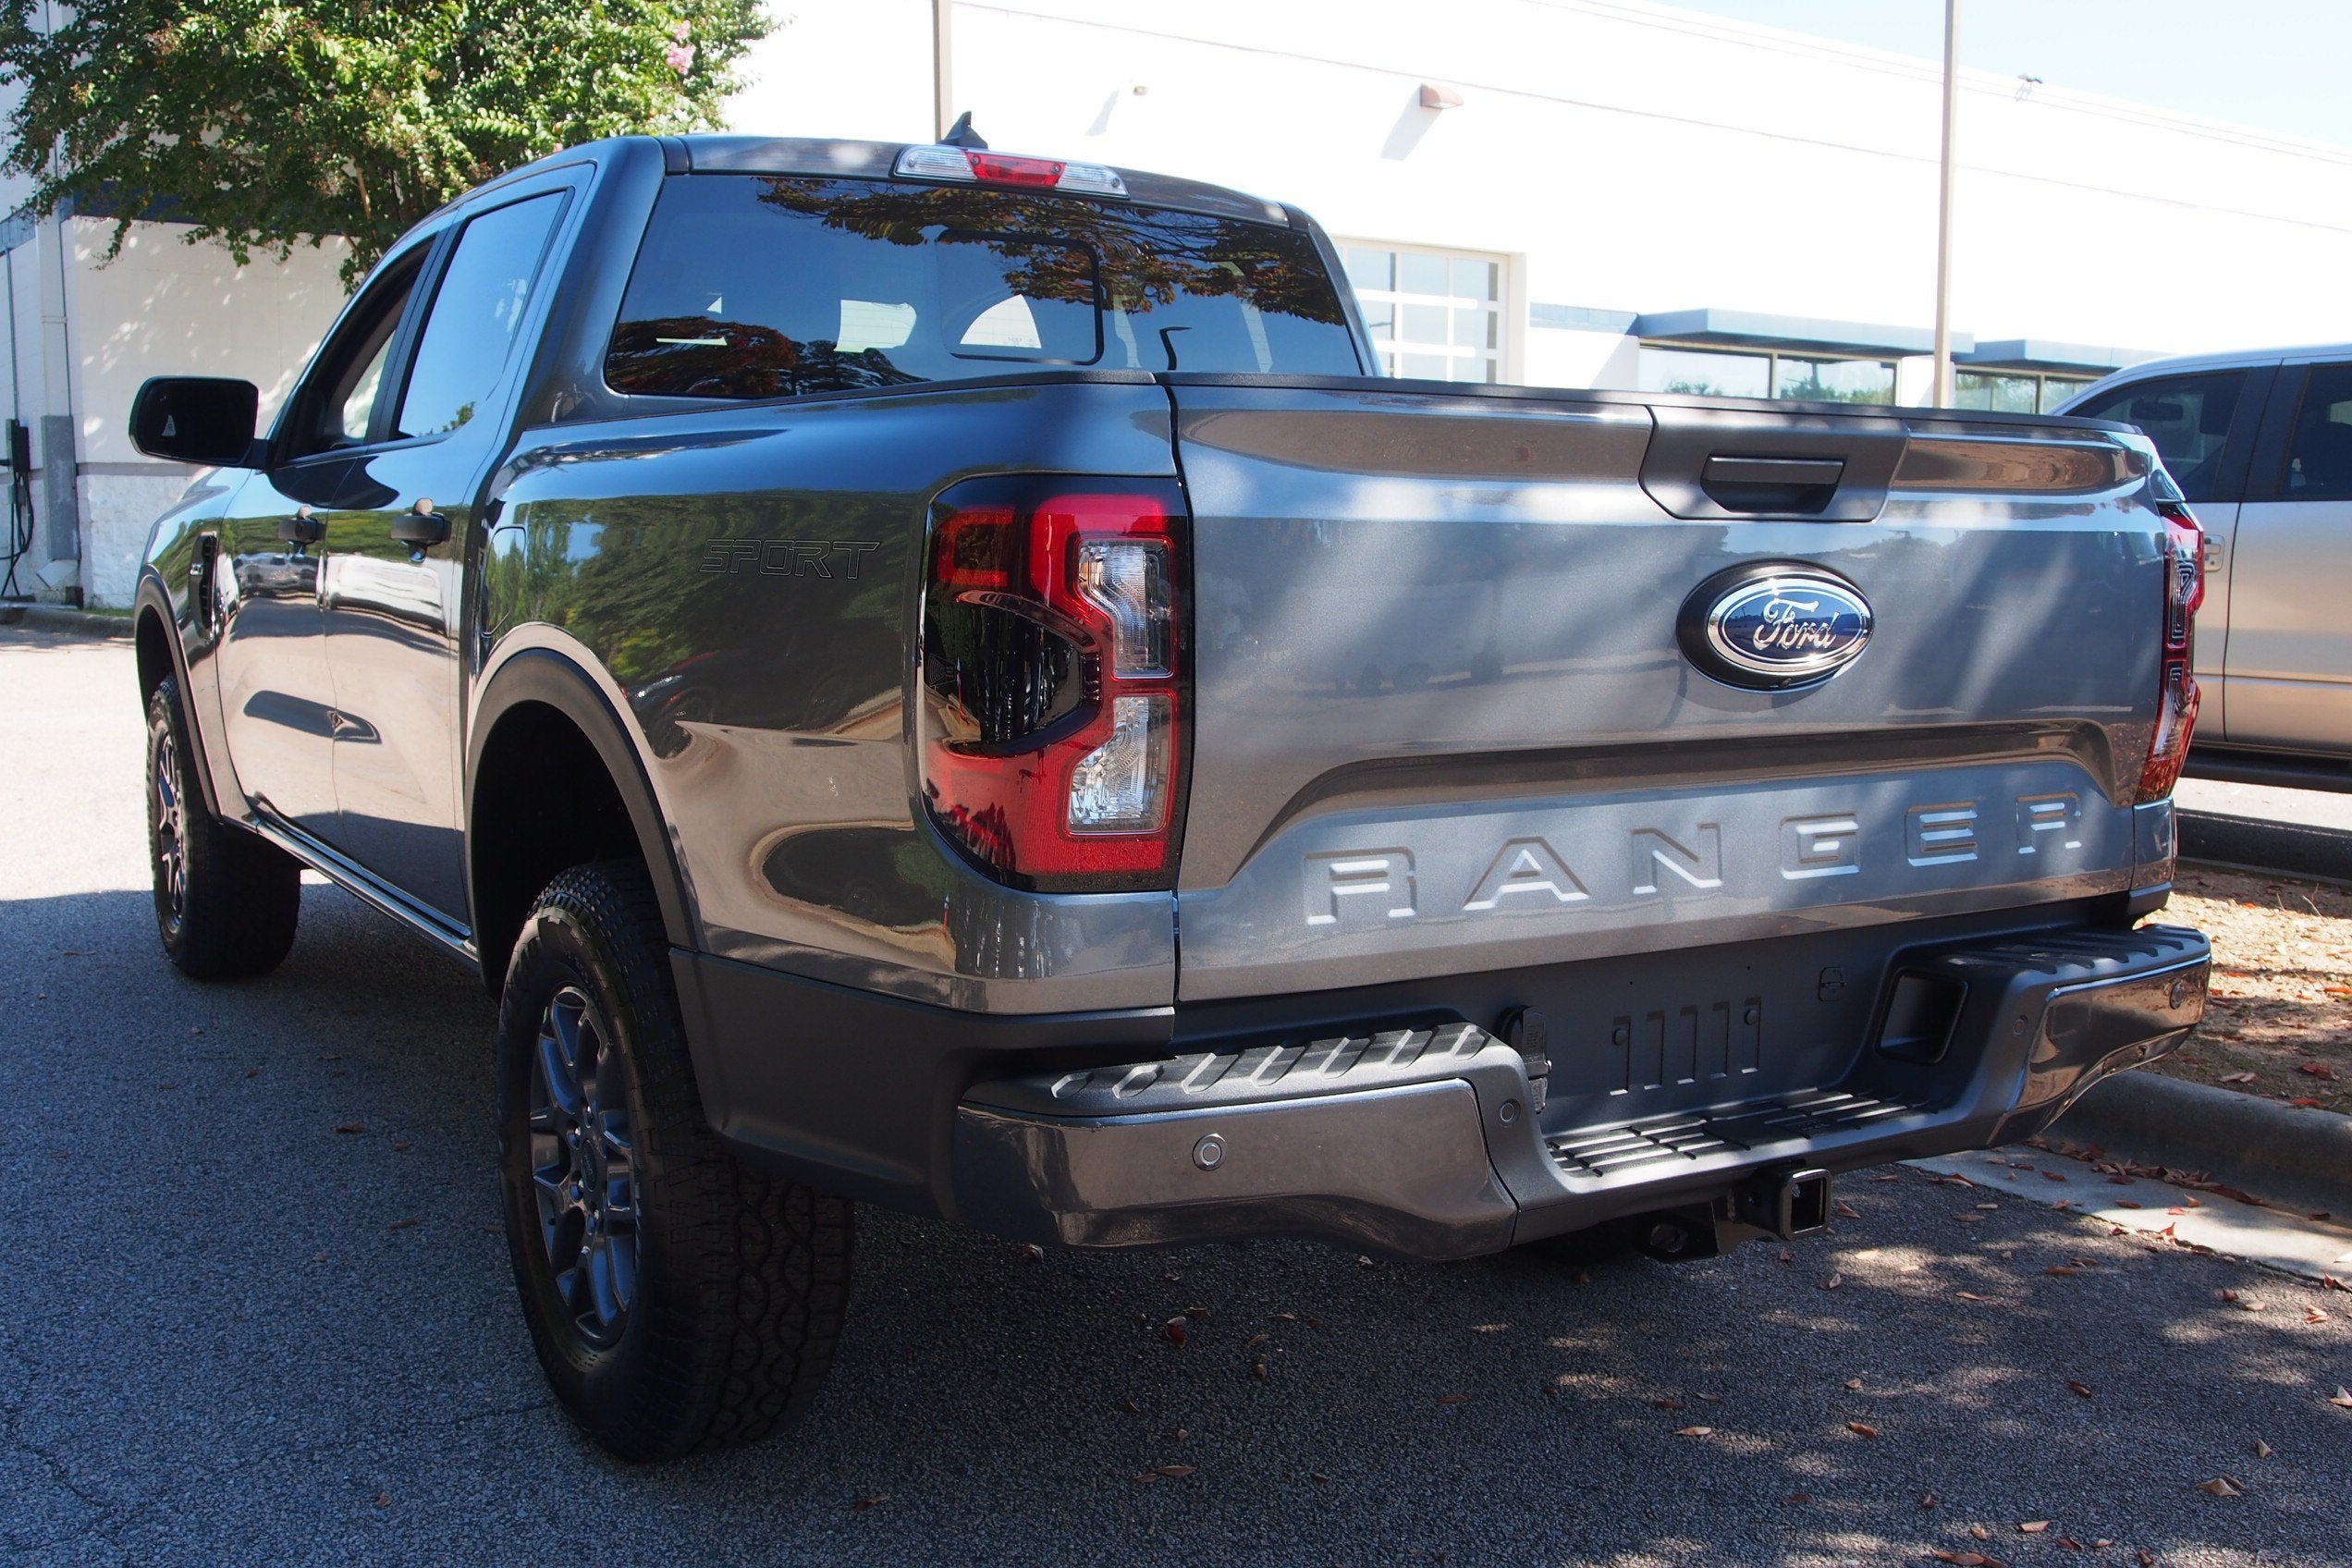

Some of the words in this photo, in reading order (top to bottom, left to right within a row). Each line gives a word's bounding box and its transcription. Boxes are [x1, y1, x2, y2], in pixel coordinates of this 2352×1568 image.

[698, 538, 881, 581] SPORT
[1753, 597, 1840, 651] Ford
[1303, 790, 2085, 927] RANGER
